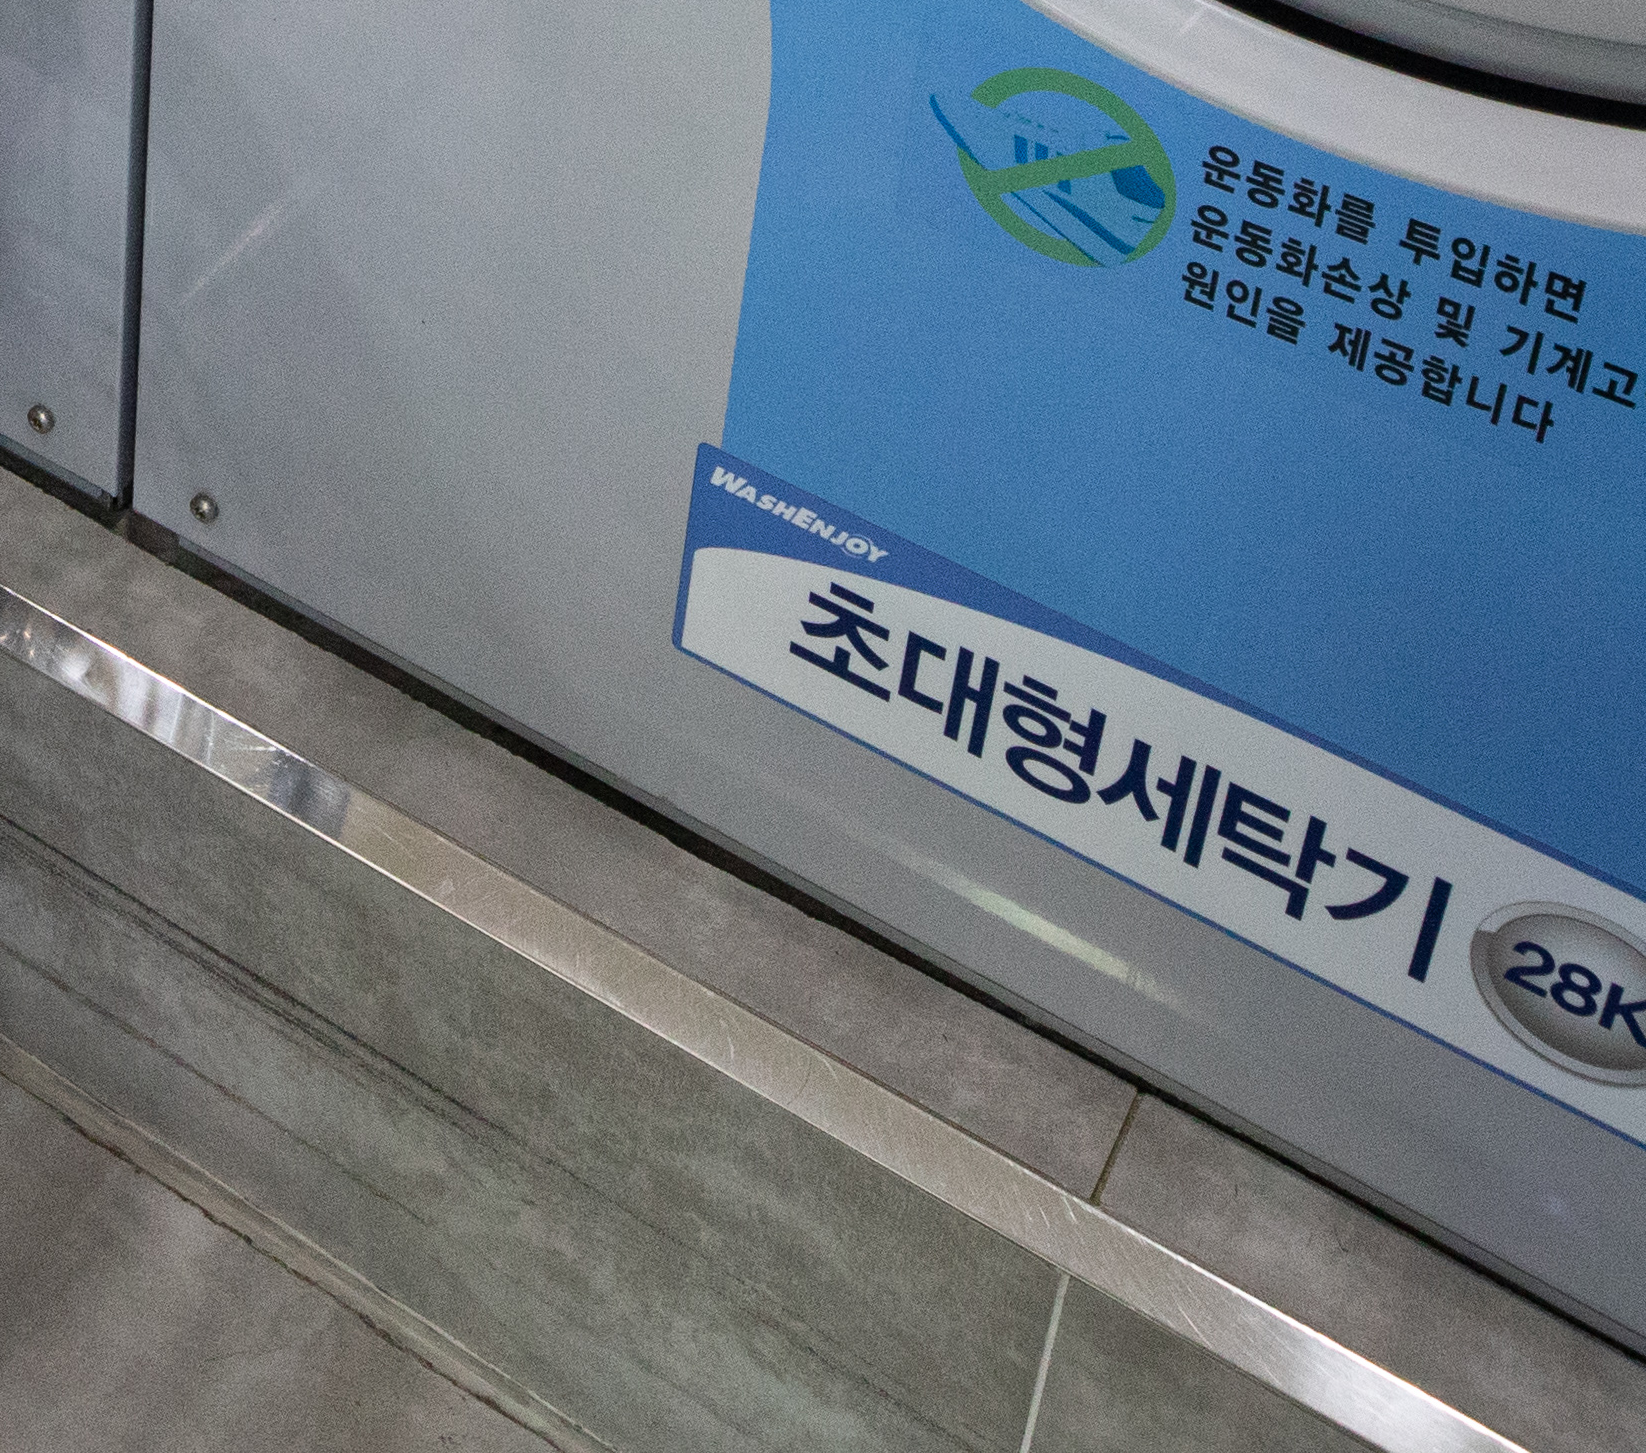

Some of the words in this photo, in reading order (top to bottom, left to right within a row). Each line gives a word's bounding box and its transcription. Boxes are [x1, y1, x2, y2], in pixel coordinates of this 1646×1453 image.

[1190, 202, 1412, 321] 운동화손상
[1435, 296, 1476, 348] 및
[1201, 143, 1379, 245] 운동화를
[1399, 216, 1588, 326] 투입하면
[1180, 260, 1307, 345] 원인을
[1327, 321, 1555, 445] 제공합니다
[787, 582, 1453, 983] 초대형세탁기
